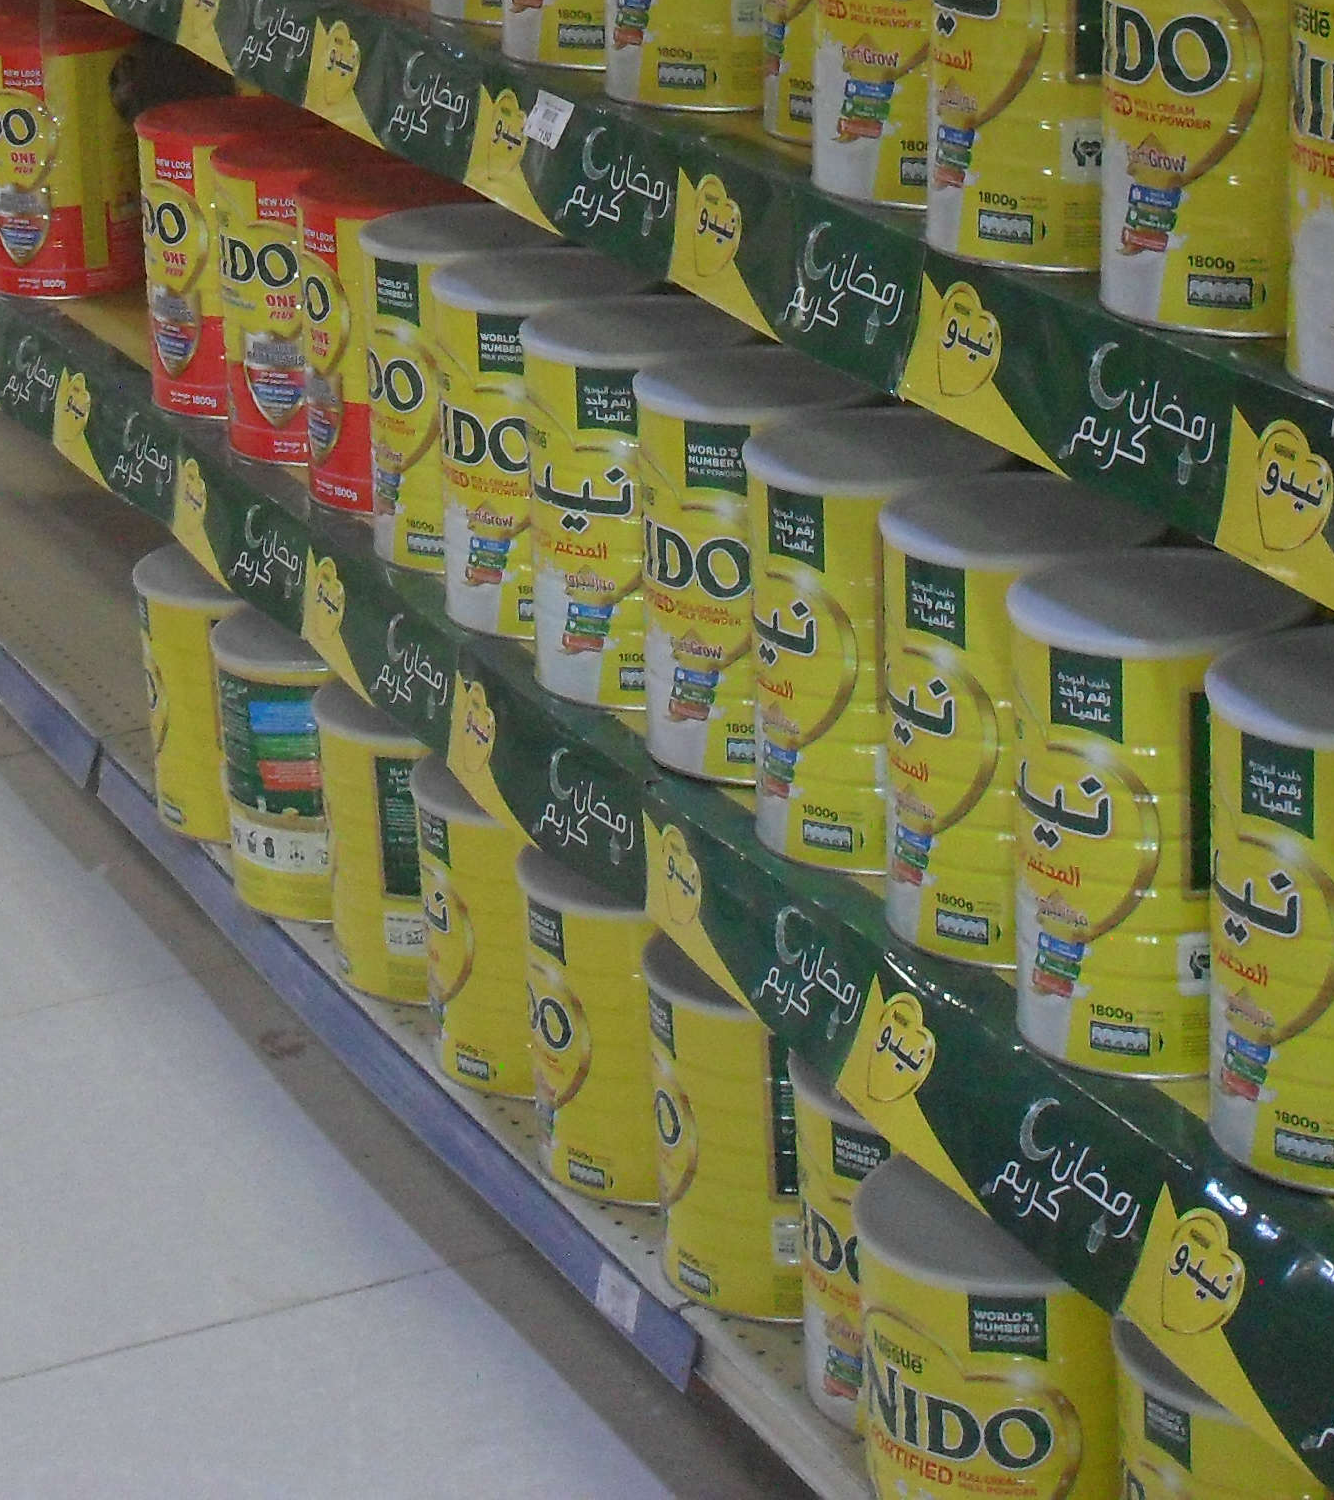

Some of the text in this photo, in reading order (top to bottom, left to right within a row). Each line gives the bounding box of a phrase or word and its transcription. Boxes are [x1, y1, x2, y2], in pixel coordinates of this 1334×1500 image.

[1116, 0, 1231, 96] DO
[388, 101, 430, 142] كريم
[424, 73, 470, 126] رمضان
[564, 182, 625, 228] كريم
[609, 153, 671, 219] رمضان
[978, 191, 1018, 209] 1800g
[1187, 255, 1236, 272] 1800g
[265, 294, 297, 309] ONE
[784, 284, 846, 331] كريم
[829, 252, 906, 326] رمضان
[941, 312, 995, 360] نيدو
[1068, 414, 1151, 469] كريم
[1128, 379, 1217, 464] رمضان
[688, 444, 738, 458] WORLD'S
[688, 456, 734, 468] NUMBER
[1260, 458, 1328, 509] نيدو
[1086, 689, 1112, 706] رقم
[802, 803, 838, 822] 1800g
[1276, 783, 1302, 800] رقم
[540, 801, 588, 849] كريم
[573, 781, 634, 850] رمضان
[935, 892, 974, 913] 1800g
[760, 965, 818, 1018] كريم
[799, 944, 861, 1025] رمضان
[1089, 1003, 1134, 1023] 1800g
[875, 1023, 927, 1072] نيدو
[1274, 1108, 1320, 1133] 1800g
[991, 1159, 1071, 1222] كريم
[1049, 1140, 1141, 1239] رمضان
[1169, 1242, 1235, 1301] نيدو
[973, 1309, 1034, 1323] WORLD'S
[973, 1320, 1029, 1335] NUMBER
